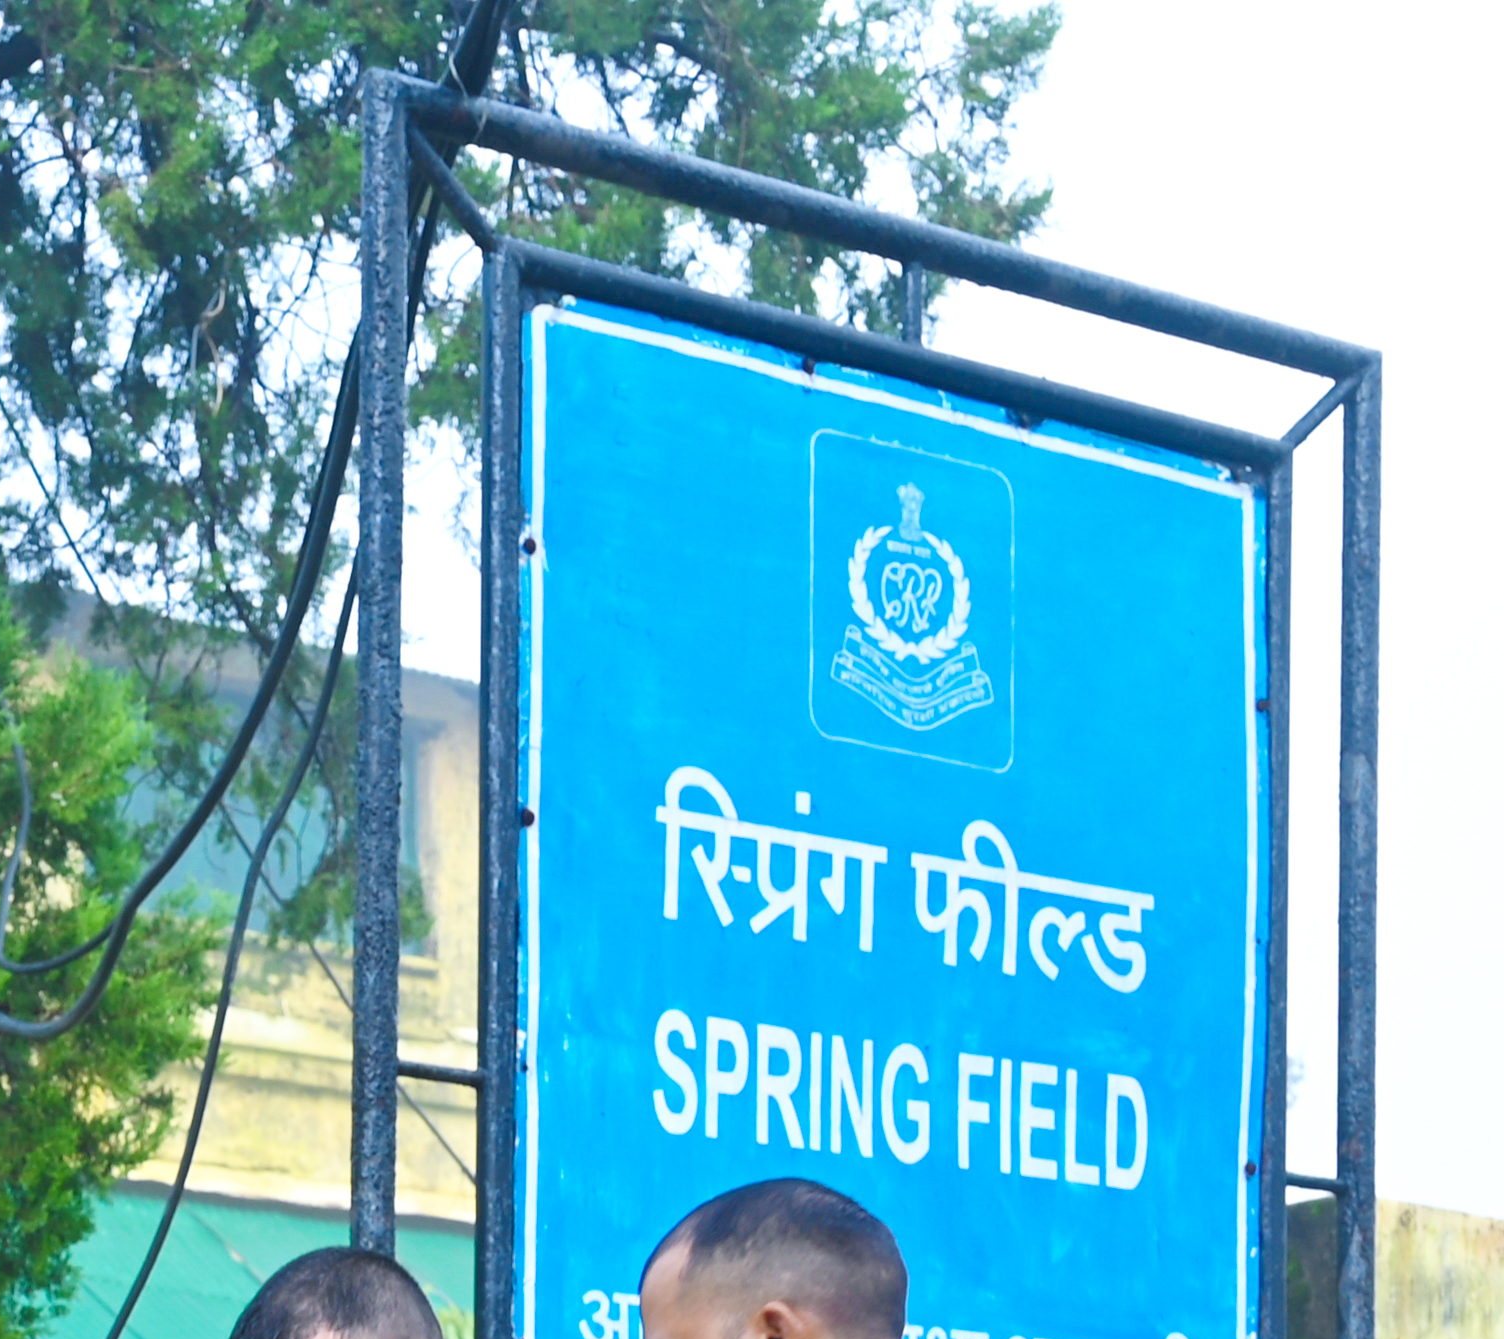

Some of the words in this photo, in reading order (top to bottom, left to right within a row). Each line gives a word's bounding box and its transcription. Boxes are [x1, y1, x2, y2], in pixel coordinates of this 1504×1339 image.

[655, 765, 888, 953] स्प्रिंग
[911, 819, 1155, 994] फील्ड
[652, 1008, 931, 1165] SPRING
[957, 1052, 1149, 1191] FIELD
